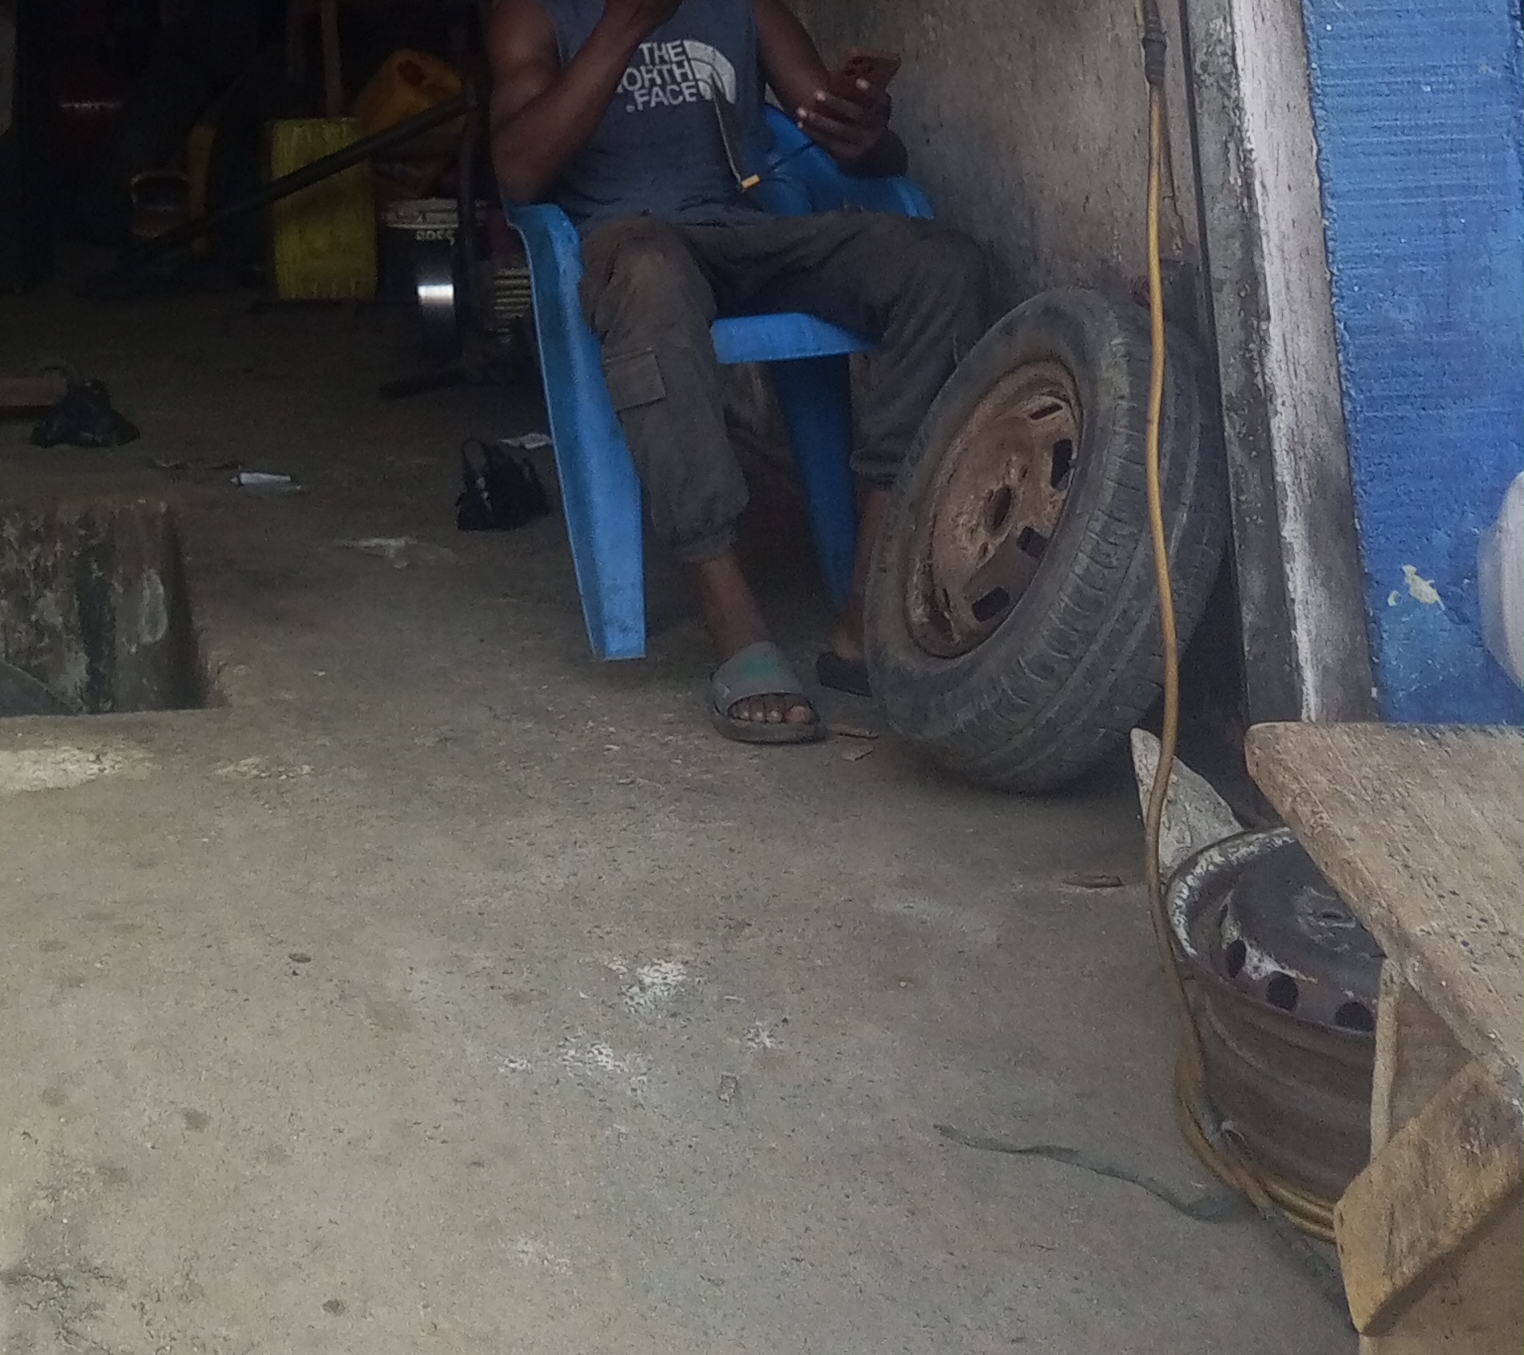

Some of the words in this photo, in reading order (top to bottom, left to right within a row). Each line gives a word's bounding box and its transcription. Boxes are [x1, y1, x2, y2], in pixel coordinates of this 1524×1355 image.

[638, 38, 687, 65] THE
[615, 60, 694, 94] ORTH
[633, 81, 698, 112] FACE
